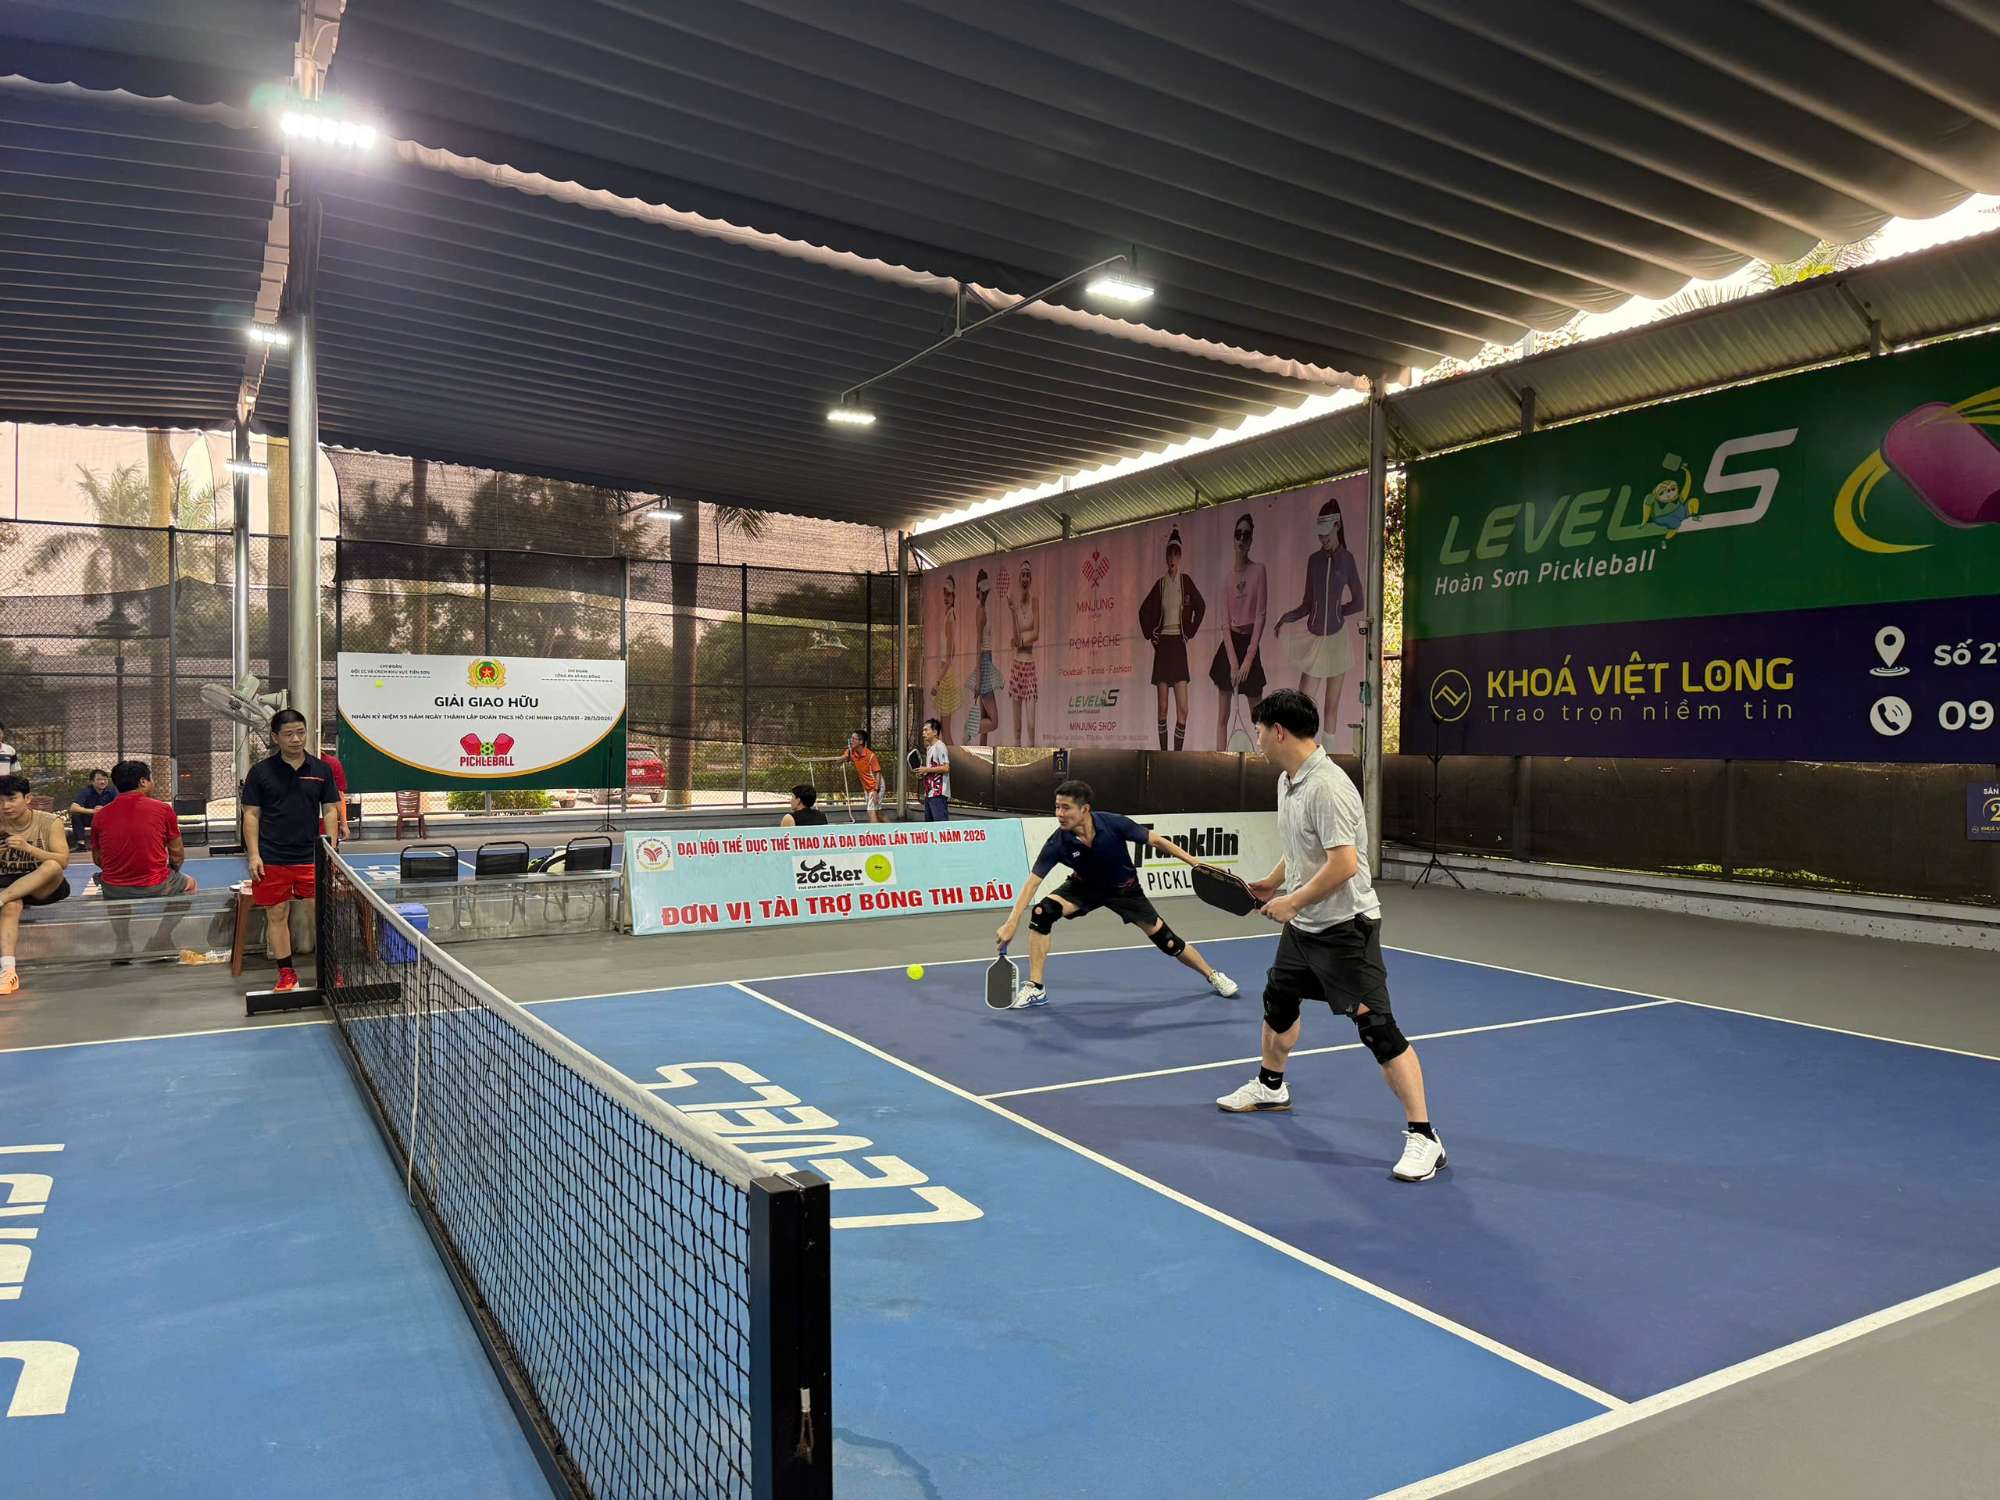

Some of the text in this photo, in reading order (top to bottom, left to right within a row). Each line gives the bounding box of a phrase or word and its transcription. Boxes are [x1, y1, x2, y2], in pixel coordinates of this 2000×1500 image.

[1435, 549, 1656, 596] Hoàn Sơn Pickleball
[1934, 639, 2000, 666] Số 2
[1487, 651, 1794, 701] KHOÁ VIỆT LONG
[434, 693, 539, 708] GIẢI GIAO HỮU
[1487, 699, 1792, 725] Trao trọn niềm tin
[1938, 700, 1995, 731] 09
[1983, 786, 2000, 795] SÂN
[677, 842, 698, 858] ĐẠI
[700, 838, 720, 857] HỘI
[746, 838, 768, 855] DỤC
[793, 836, 820, 850] THAO
[822, 833, 837, 849] XÃ
[839, 834, 856, 850] ĐẠI
[963, 829, 986, 842] 2026
[662, 879, 1013, 926] ĐƠN VỊ TÀI TRỢ BÓNG THI ĐẤU
